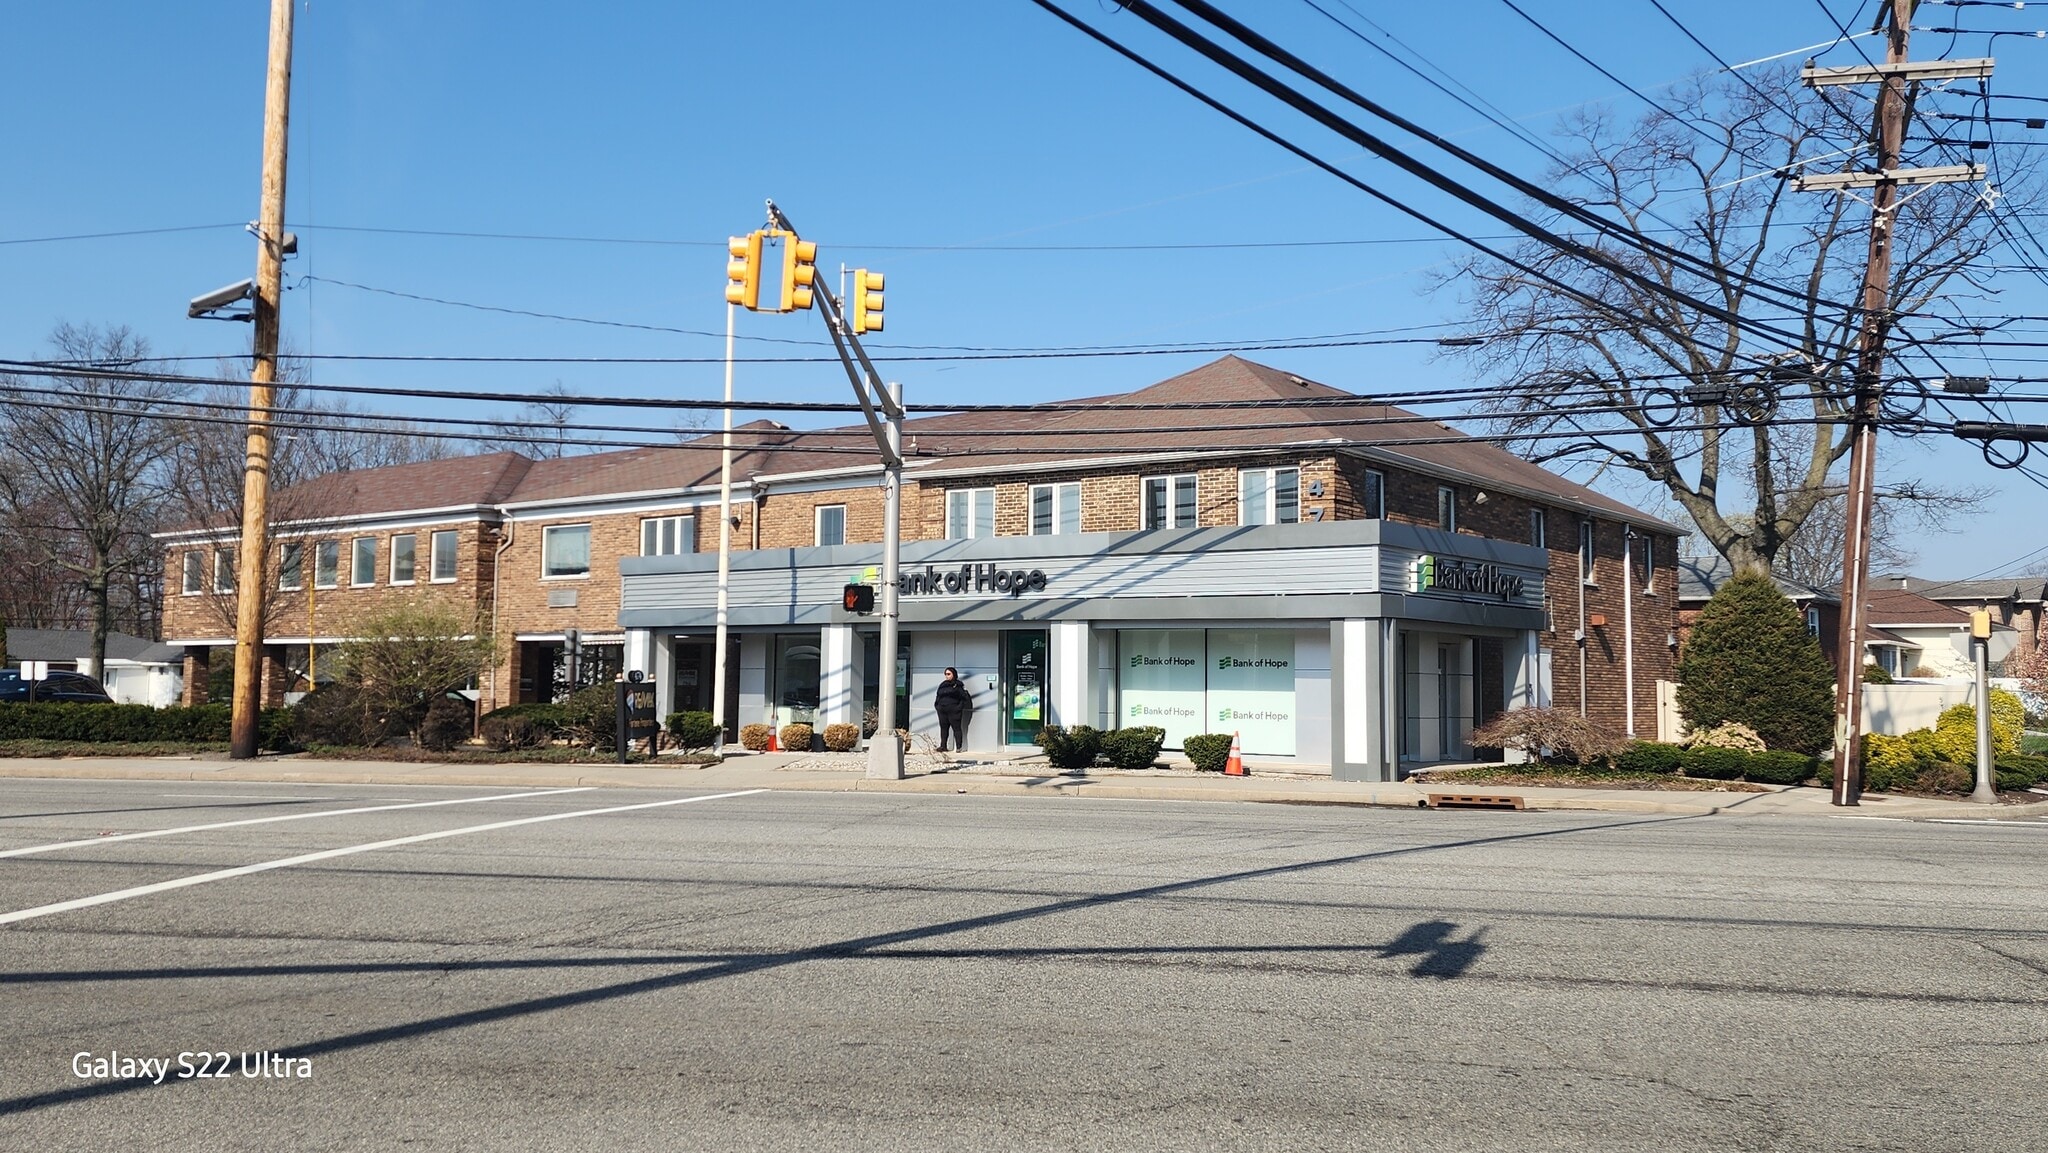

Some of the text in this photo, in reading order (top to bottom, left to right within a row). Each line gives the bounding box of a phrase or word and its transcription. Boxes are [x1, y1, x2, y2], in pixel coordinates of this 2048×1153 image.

[899, 563, 1046, 597] ank of Hope
[1435, 557, 1524, 602] Bank of Hope
[1144, 656, 1196, 668] Bank of Hope
[1233, 658, 1288, 669] Bank of Hope
[1144, 707, 1195, 718] Bank of Hope
[1233, 710, 1289, 722] Bank of Hope
